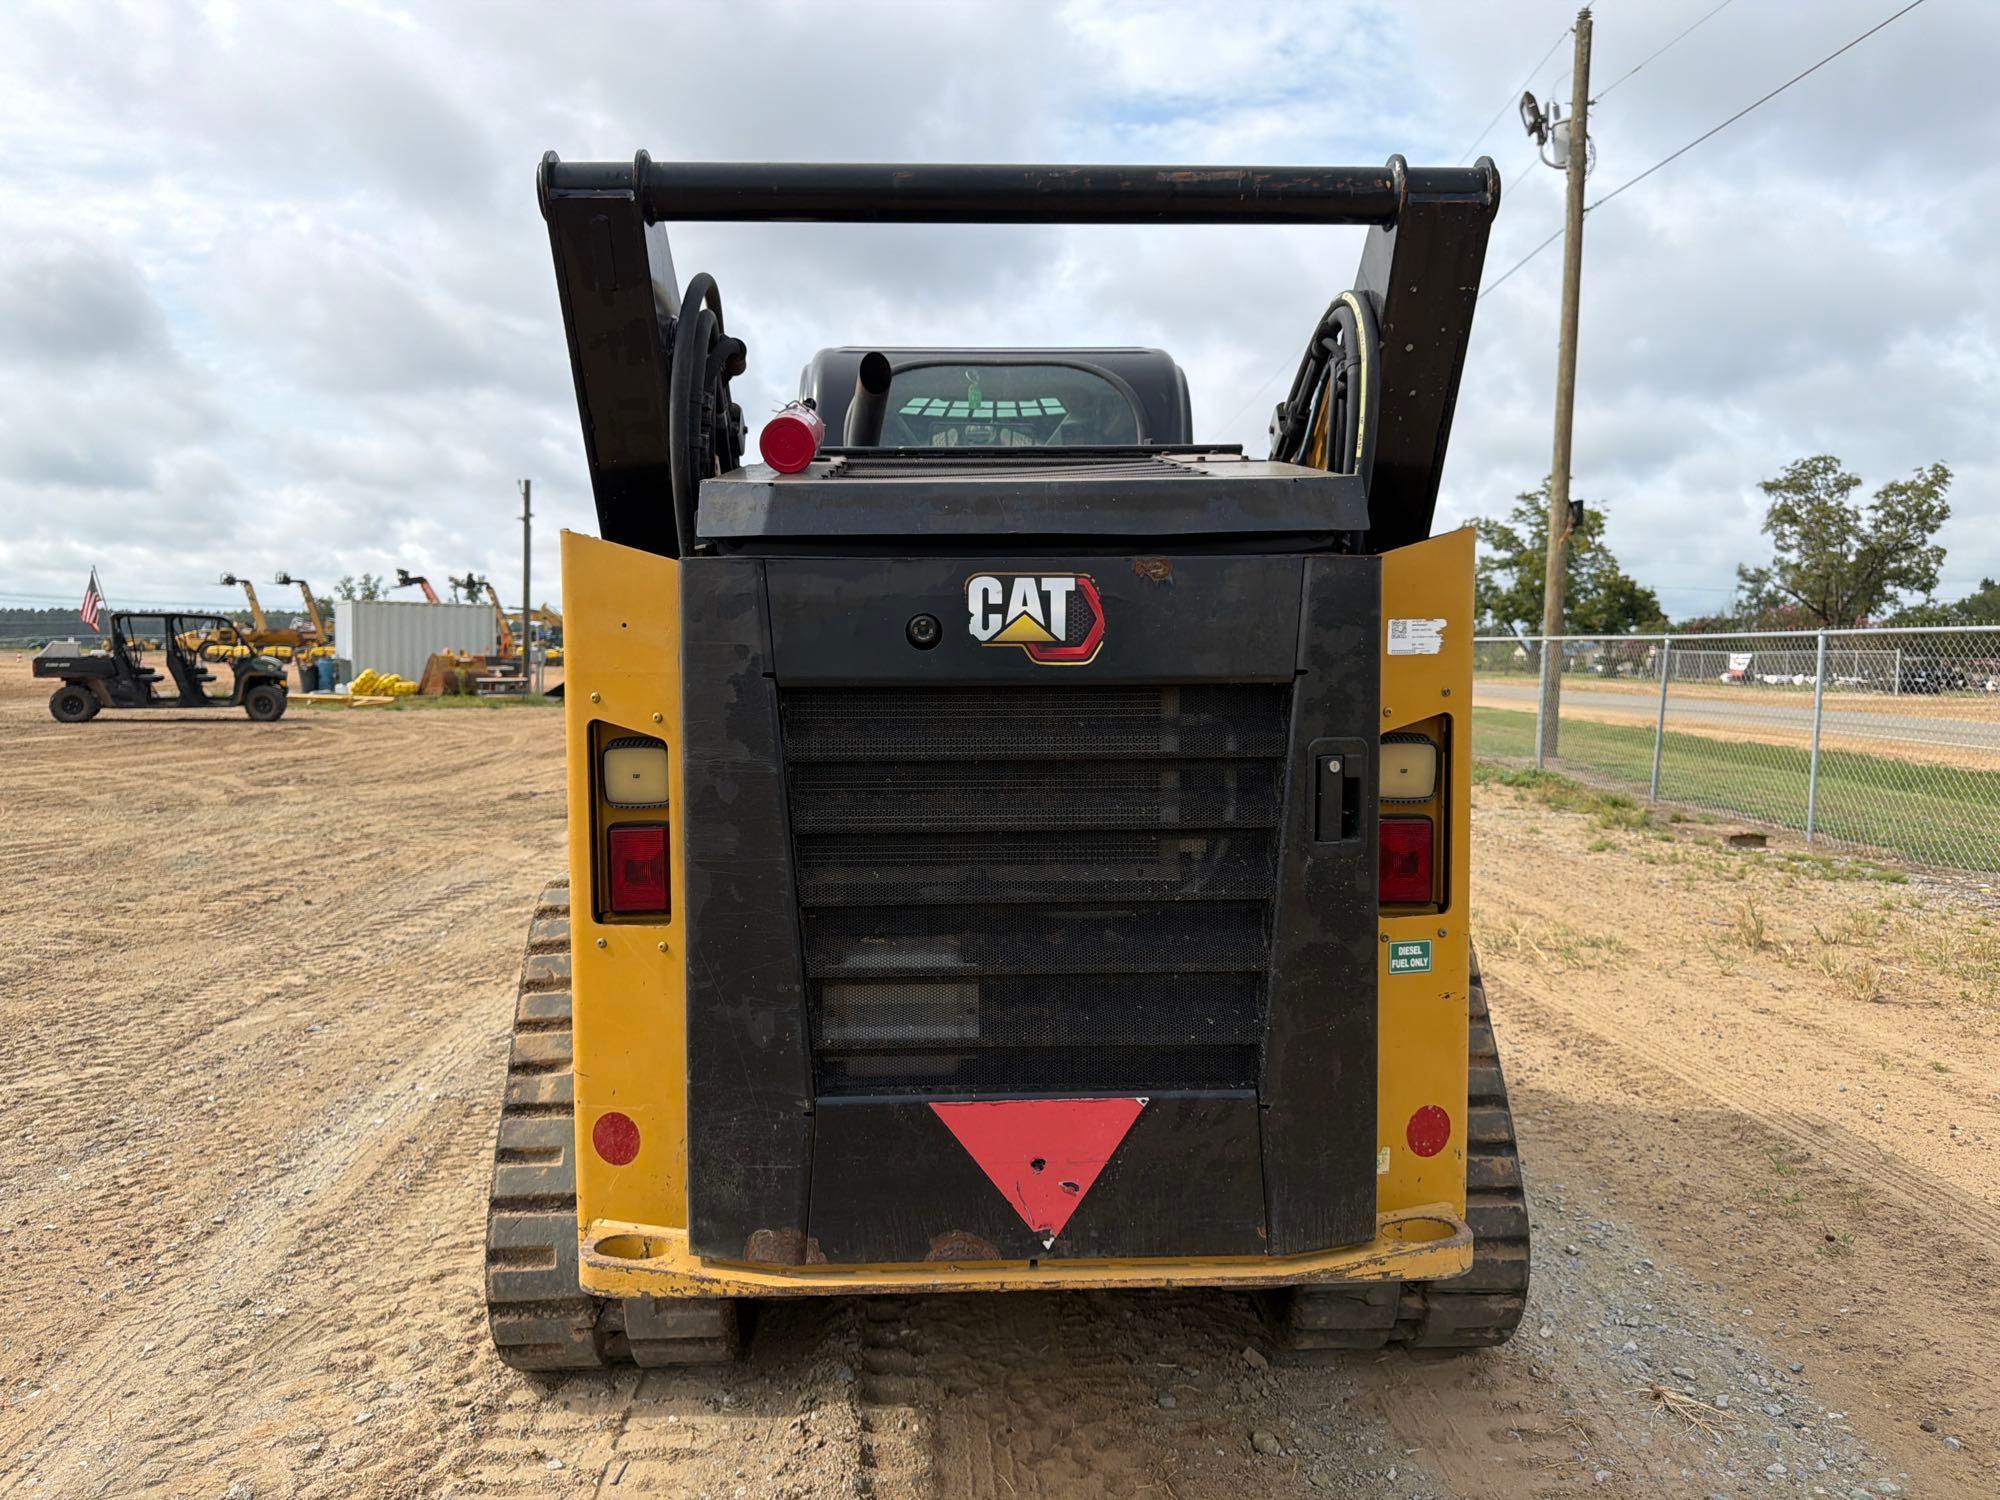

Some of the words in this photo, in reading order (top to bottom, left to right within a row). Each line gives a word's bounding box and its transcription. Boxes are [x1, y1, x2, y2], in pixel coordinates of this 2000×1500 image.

[968, 576, 1076, 642] CAT
[1398, 945, 1422, 956] DIESEL
[1391, 958, 1409, 968] FUEL
[1410, 957, 1428, 967] ONLY
